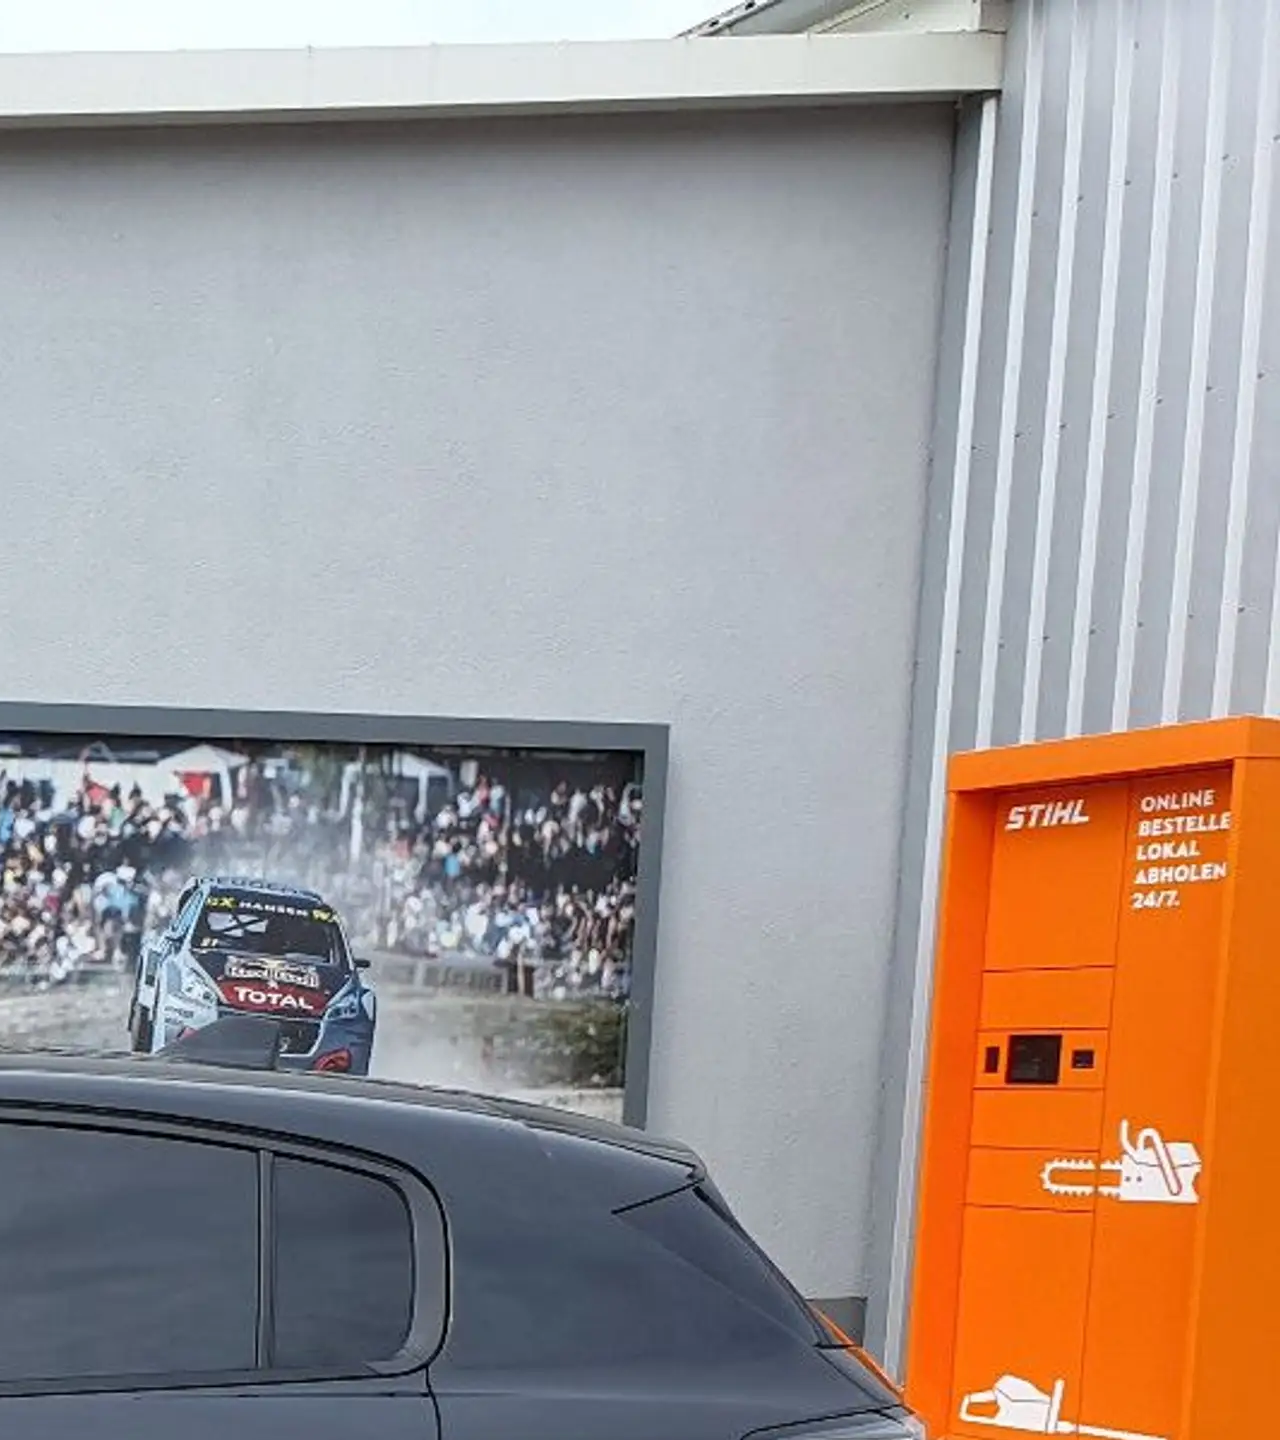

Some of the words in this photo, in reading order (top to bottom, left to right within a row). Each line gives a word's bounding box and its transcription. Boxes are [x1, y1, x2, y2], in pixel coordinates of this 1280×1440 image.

[1140, 789, 1216, 813] ONLINE
[1005, 799, 1089, 831] STIHL
[1138, 811, 1232, 837] BESTELLE
[1136, 840, 1201, 861] LOKAL
[1134, 862, 1227, 885] ABHOLEN
[234, 986, 314, 1009] TOTAL
